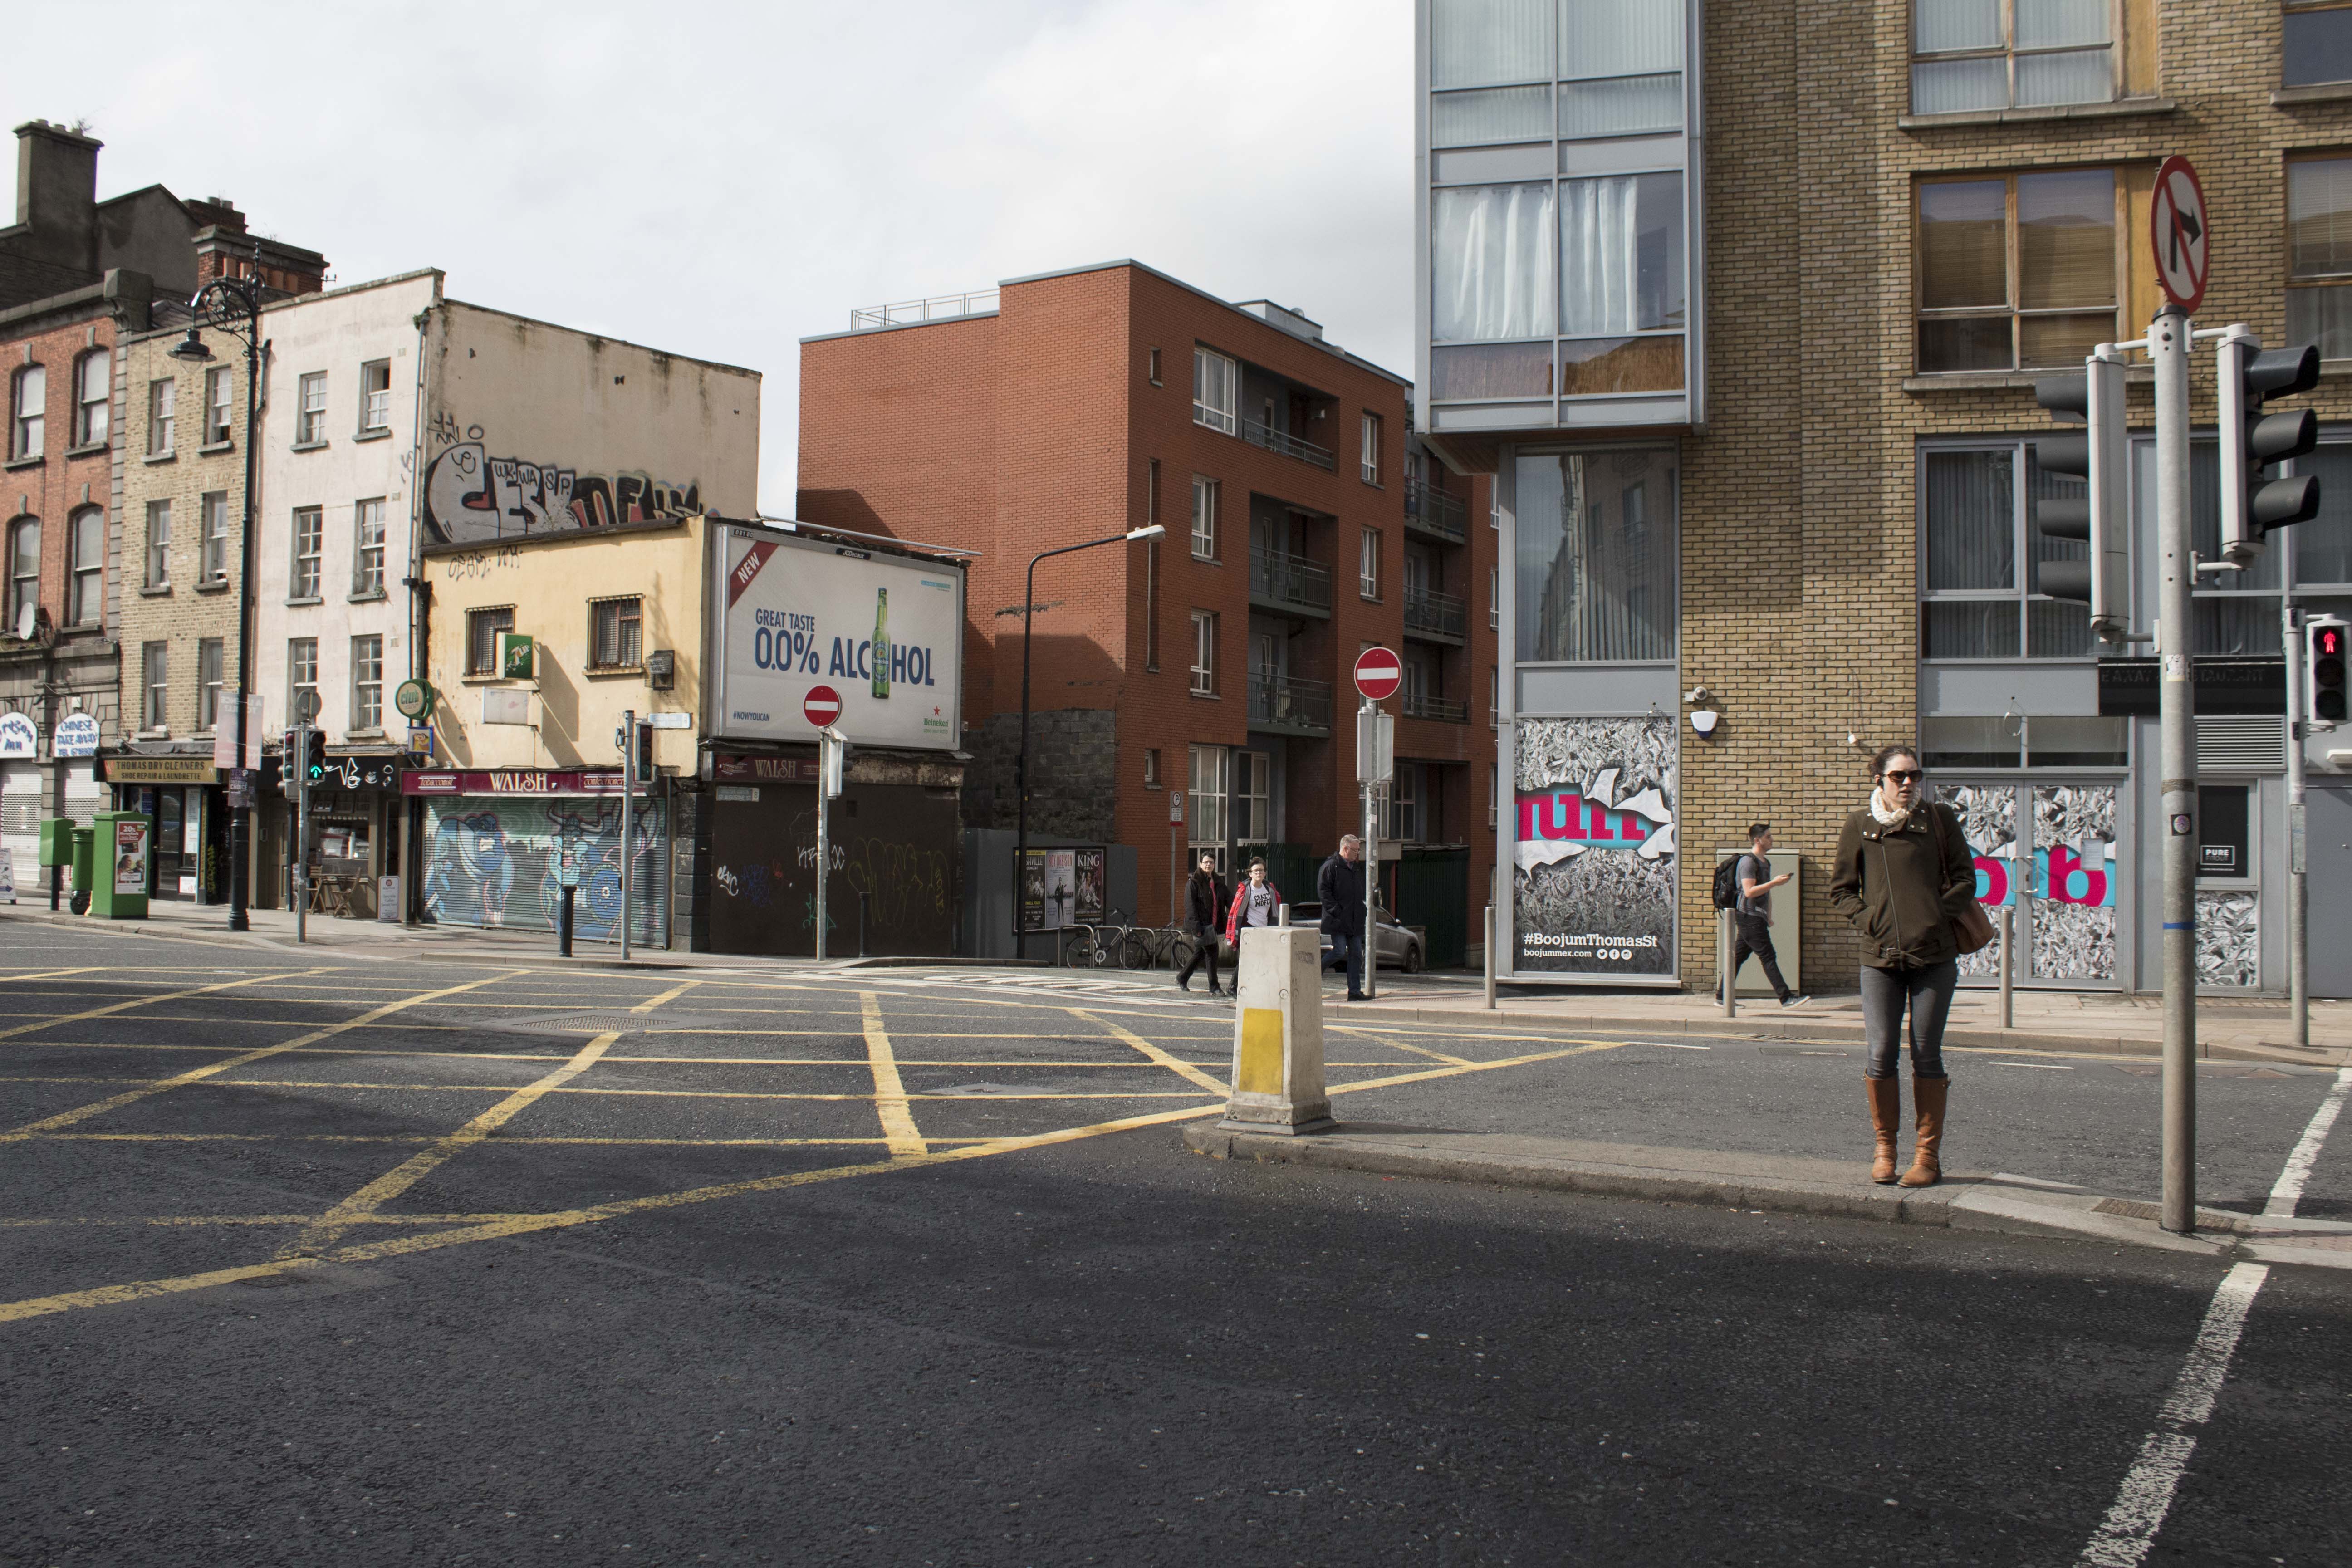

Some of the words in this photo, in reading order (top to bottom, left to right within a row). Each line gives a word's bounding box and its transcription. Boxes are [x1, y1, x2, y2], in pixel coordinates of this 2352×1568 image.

[843, 550, 864, 559] JCDecaux
[737, 552, 760, 584] NEW
[755, 608, 786, 628] GREAT
[789, 613, 815, 632] TASTE
[755, 627, 820, 675] 0.0%
[829, 637, 935, 686] ALCHOL
[733, 711, 770, 722] #NOWYOUCAN
[924, 718, 949, 727] Heineken
[60, 720, 93, 732] CHINESE
[56, 735, 74, 745] TAKE
[116, 761, 146, 770] THOMAS
[148, 761, 163, 770] DRY
[755, 760, 796, 778] WALSH
[490, 773, 549, 792] WALSH
[1057, 855, 1072, 867] ORBISON
[1078, 855, 1100, 867] KING
[1254, 892, 1269, 901] CRAZY
[1524, 932, 1657, 949] #BoojumThomasSt
[1523, 948, 1592, 959] boojummex.com
